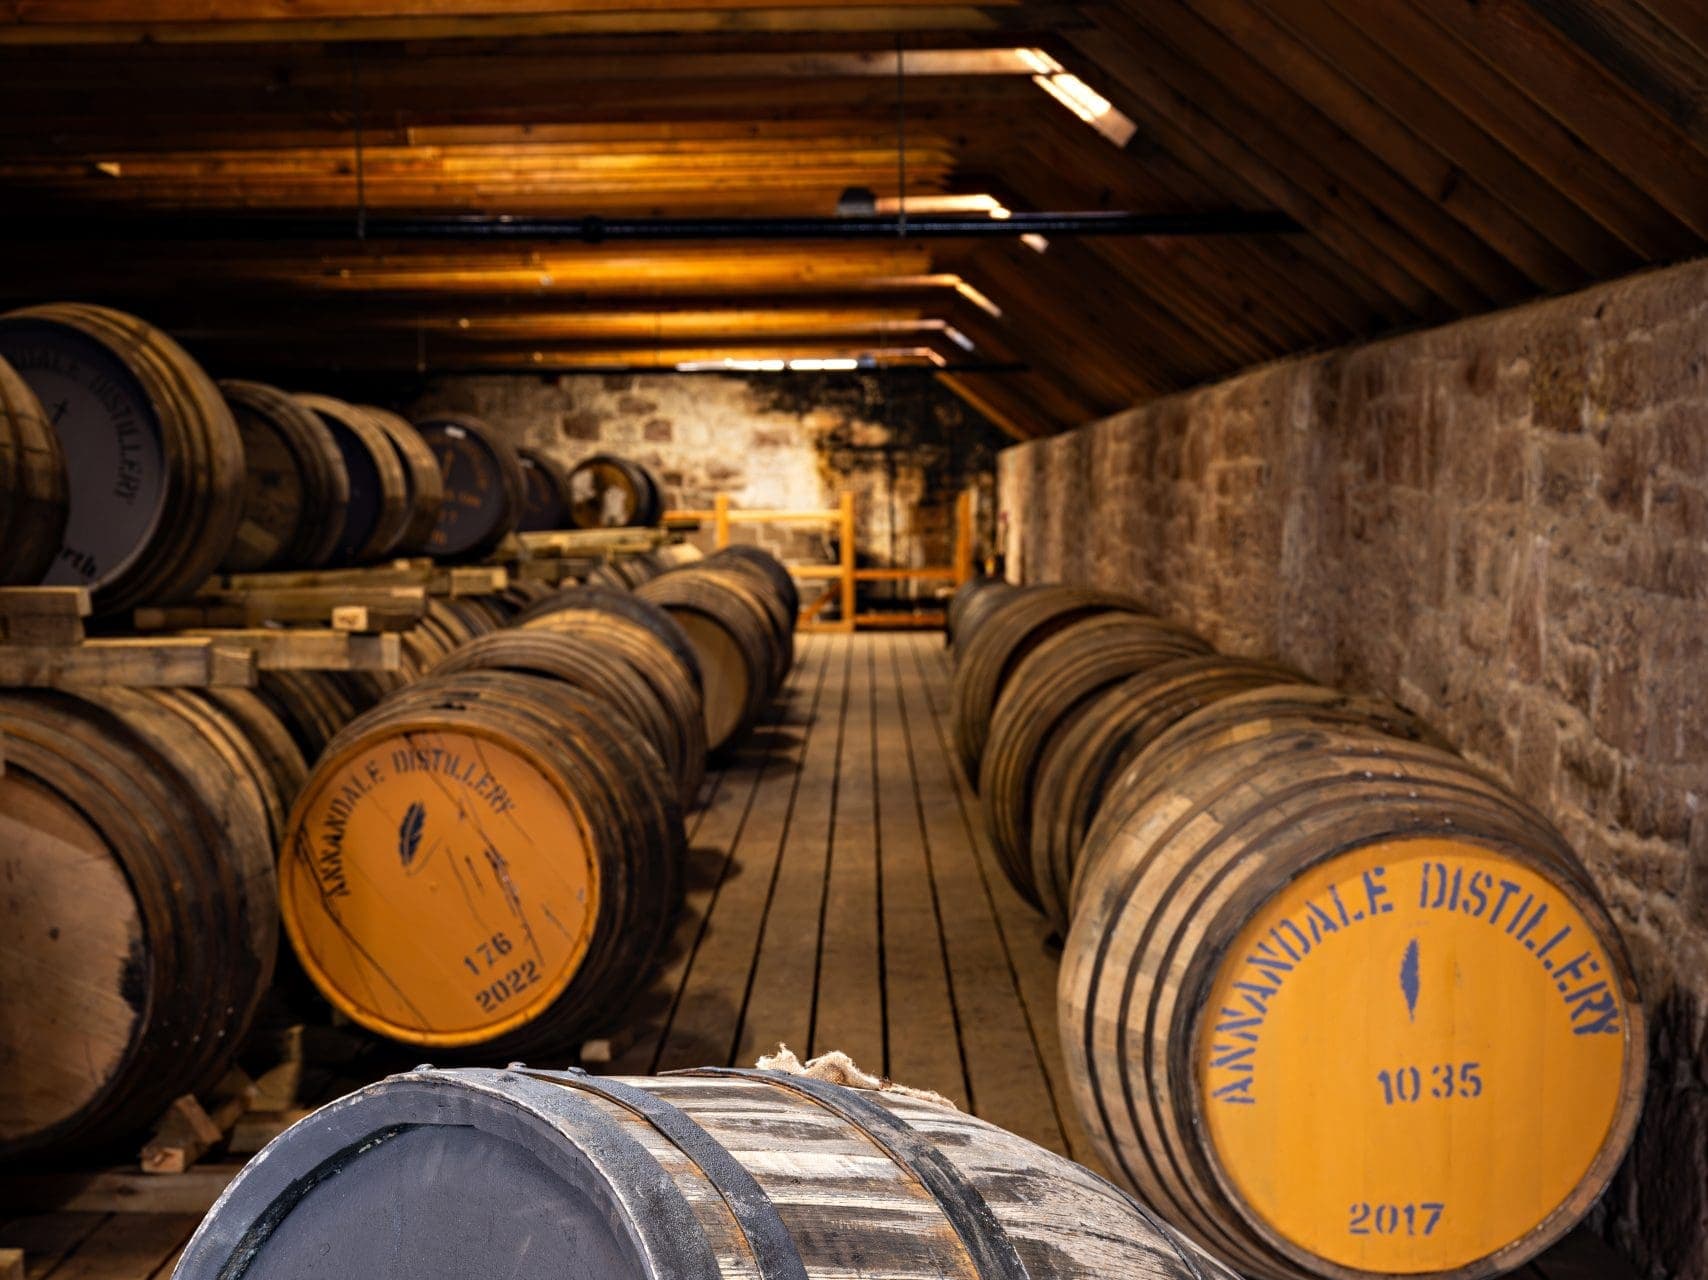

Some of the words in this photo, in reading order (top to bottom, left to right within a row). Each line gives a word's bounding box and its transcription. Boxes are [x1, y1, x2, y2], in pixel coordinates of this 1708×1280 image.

[320, 760, 386, 898] ANNANDALE
[392, 749, 516, 815] DISTILLERY
[464, 932, 513, 976] 176
[475, 959, 542, 1013] 2022
[1208, 866, 1395, 1105] ANNANDALE
[1419, 862, 1620, 1036] DISTILLERY
[1377, 1062, 1483, 1105] 1035
[1348, 1202, 1445, 1236] 2017
